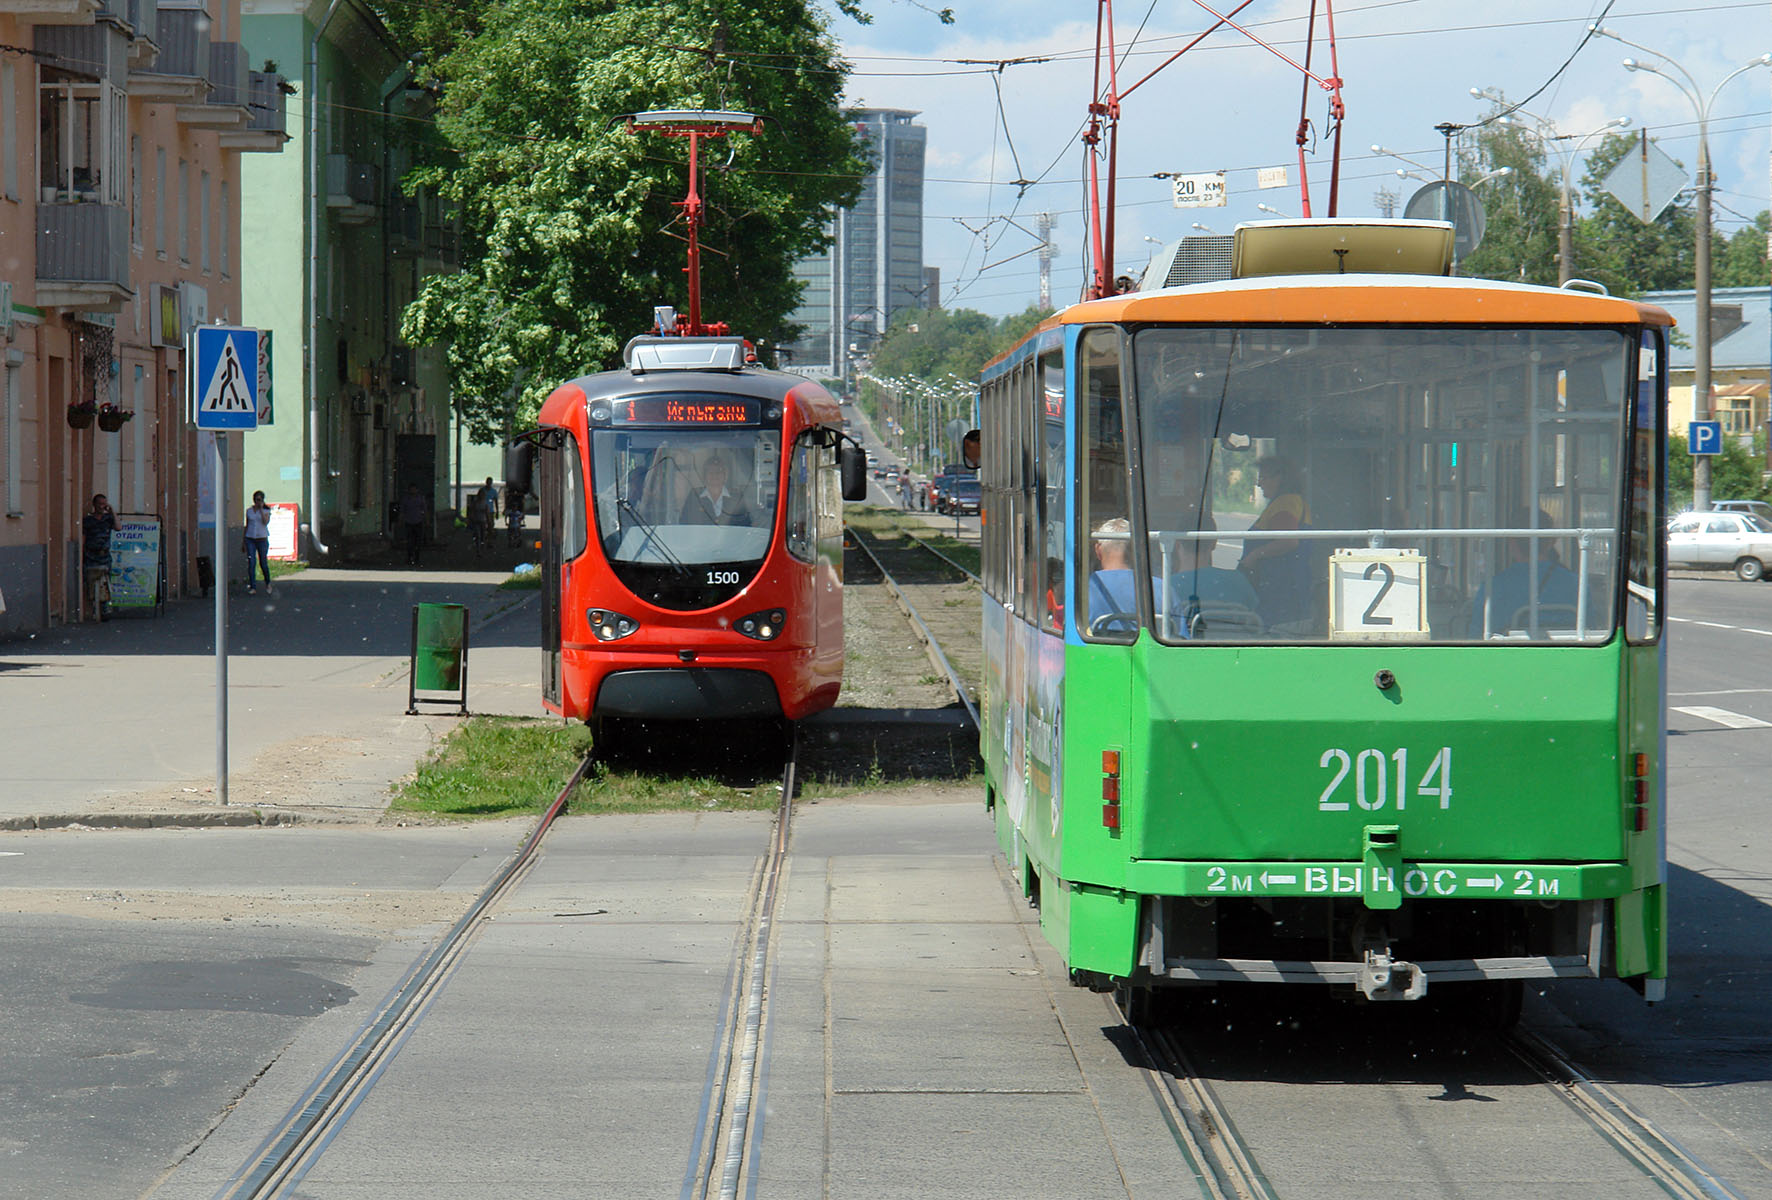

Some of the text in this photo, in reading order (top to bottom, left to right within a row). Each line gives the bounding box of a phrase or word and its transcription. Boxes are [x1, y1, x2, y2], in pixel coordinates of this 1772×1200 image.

[1176, 181, 1195, 195] 20
[1696, 425, 1713, 451] P
[706, 571, 740, 584] 1500
[1362, 562, 1394, 625] 2
[1319, 746, 1453, 811] 2014
[1304, 867, 1457, 895] ВЫНОС
